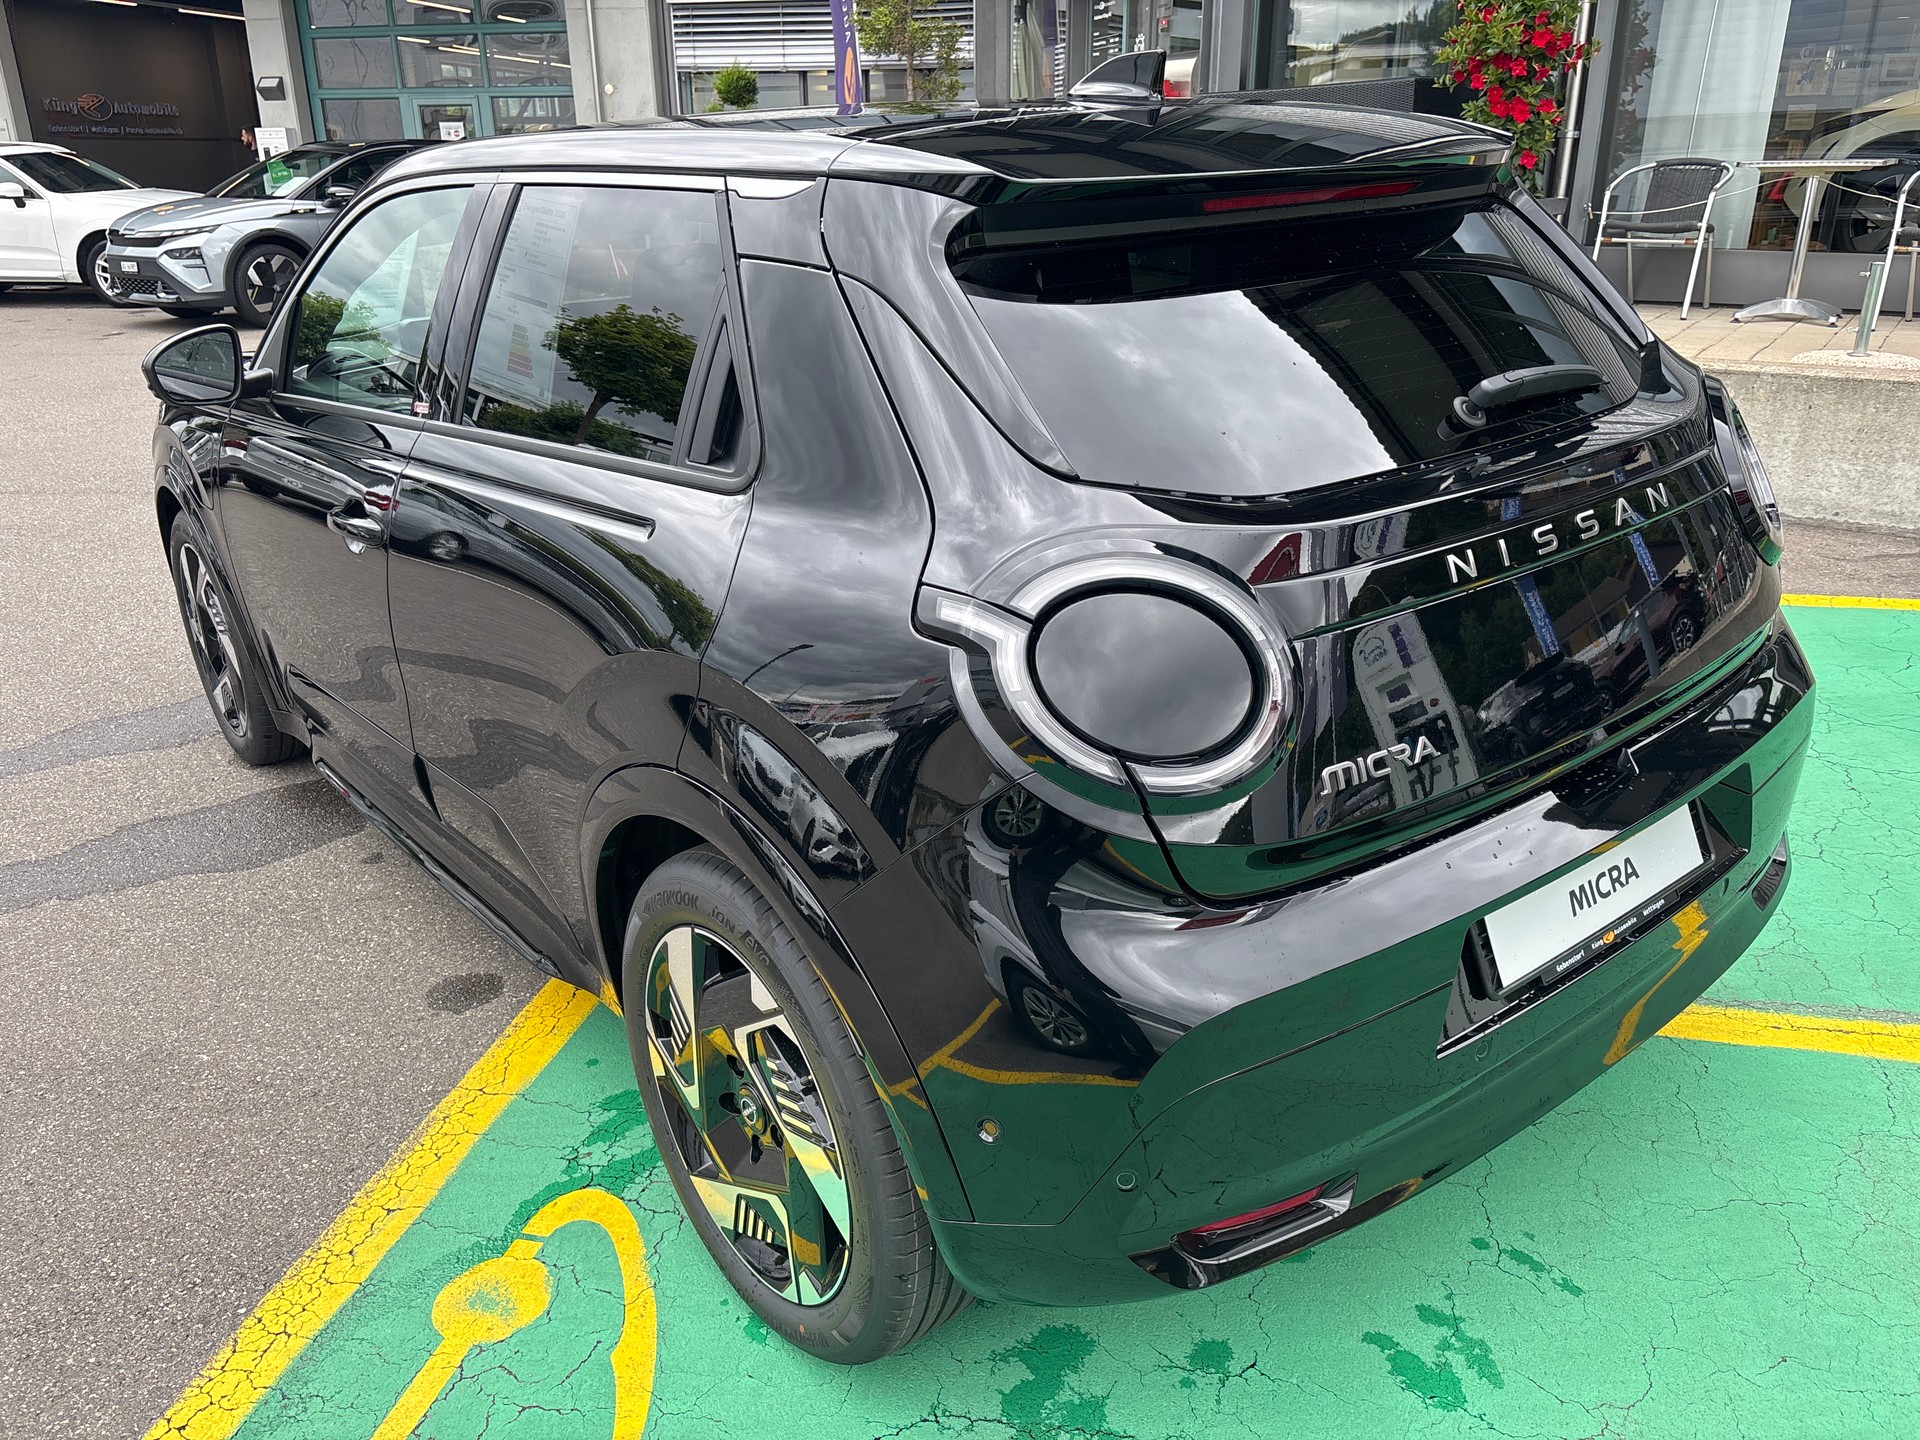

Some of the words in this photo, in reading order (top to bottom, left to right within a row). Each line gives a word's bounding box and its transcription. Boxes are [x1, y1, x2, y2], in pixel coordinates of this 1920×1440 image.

[42, 97, 78, 115] Küng
[113, 101, 180, 116] Automobile
[1446, 482, 1669, 584] NISSAN
[1320, 735, 1442, 797] MICRA
[1568, 857, 1640, 918] MICRA
[1556, 949, 1585, 972] Gebenstorf
[1591, 938, 1604, 950] Küng
[1614, 917, 1637, 935] Automobile
[1643, 899, 1665, 916] Wettingen
